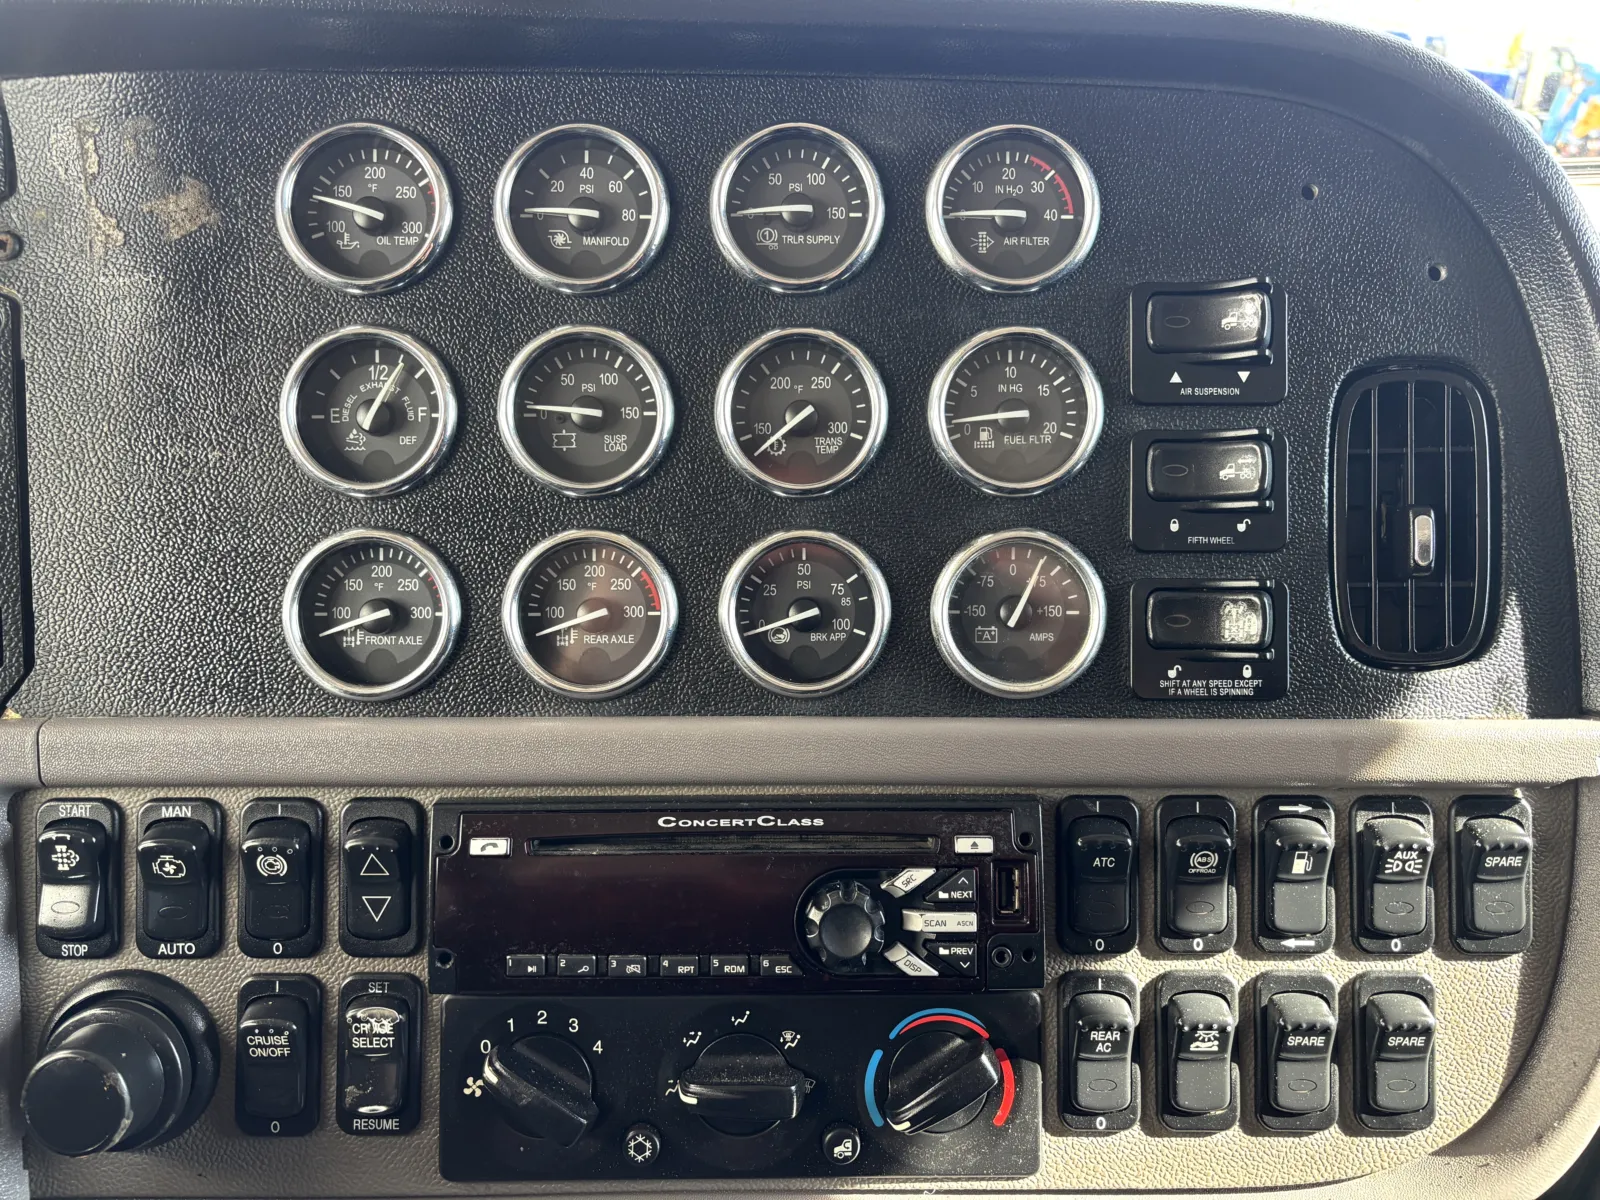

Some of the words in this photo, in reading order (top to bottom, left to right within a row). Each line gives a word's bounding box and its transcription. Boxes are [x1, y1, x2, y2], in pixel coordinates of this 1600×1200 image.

[364, 167, 385, 179] 200
[580, 168, 594, 179] 40
[1002, 168, 1016, 180] 20
[768, 174, 782, 186] 50
[806, 174, 825, 186] 100
[332, 186, 352, 198] 150
[395, 187, 417, 198] 250
[551, 181, 564, 193] 20
[579, 185, 594, 194] PSI
[609, 181, 622, 193] 60
[789, 184, 803, 192] PSI
[972, 182, 983, 193] 10
[995, 185, 1002, 194] IN
[1031, 181, 1044, 193] 30
[622, 209, 635, 221] 80
[826, 207, 845, 219] 150
[1044, 210, 1057, 221] 40
[326, 221, 346, 233] 100
[402, 222, 422, 234] 300
[376, 237, 392, 246] OIL
[394, 237, 419, 246] TEMP
[583, 237, 629, 246] MANIFOLD
[782, 235, 804, 244] TRLR
[806, 235, 840, 244] SUPPLY
[1004, 237, 1018, 246] AIR
[1020, 237, 1049, 246] FILTER
[368, 365, 388, 380] 1/2
[1005, 366, 1017, 378] 10
[561, 374, 575, 386] 50
[599, 374, 618, 385] 100
[770, 377, 791, 389] 200
[811, 377, 832, 389] 250
[582, 384, 595, 393] PSI
[971, 386, 977, 397] 5
[998, 384, 1006, 392] IN
[1008, 384, 1023, 393] HG
[1038, 384, 1049, 396] 15
[342, 394, 358, 422] DIESEL
[360, 380, 401, 394] EXHAST
[402, 396, 415, 421] FLUID
[331, 408, 340, 423] E
[418, 408, 426, 421] F
[620, 407, 639, 419] 150
[753, 423, 772, 435] 150
[827, 422, 848, 434] 300
[964, 424, 971, 435] 0
[1043, 422, 1057, 434] 20
[399, 436, 417, 445] DEF
[604, 435, 627, 443] SUSP
[814, 437, 842, 446] TRANS
[1004, 435, 1026, 444] FUEL
[1029, 435, 1052, 444] FLTR
[604, 443, 627, 452] LOAD
[816, 445, 839, 454] TEMP
[371, 565, 393, 578] 200
[584, 565, 605, 578] 200
[797, 564, 811, 576] 50
[1009, 564, 1016, 575] 0
[344, 580, 363, 591] 150
[397, 579, 419, 591] 250
[557, 579, 577, 591] 150
[610, 579, 632, 591] 250
[797, 581, 811, 589] PSI
[977, 575, 994, 588] -75
[763, 584, 777, 596] 25
[831, 583, 845, 595] 75
[841, 597, 851, 606] 85
[331, 607, 351, 619] 100
[410, 607, 432, 619] 300
[545, 606, 565, 619] 100
[623, 606, 644, 618] 300
[964, 605, 985, 617] -150
[1037, 605, 1062, 617] +150
[832, 618, 850, 630] 100
[365, 636, 396, 645] FRONT
[398, 635, 422, 645] AXLE
[584, 635, 608, 644] REAR
[610, 635, 635, 644] AXLE
[811, 633, 827, 641] BRK
[829, 632, 846, 641] APP
[1029, 633, 1054, 642] AMPS
[59, 805, 91, 816] START
[162, 806, 191, 817] MAN
[1394, 851, 1419, 859] AUX
[1093, 858, 1115, 867] ATC
[1485, 856, 1523, 867] SPARE
[902, 874, 917, 888] SRC
[924, 919, 947, 927] SCAN
[62, 944, 88, 956] STOP
[158, 943, 196, 955] AUTO
[560, 959, 565, 967] 2
[611, 960, 616, 968] 3
[904, 959, 922, 973] DISP
[678, 966, 694, 974] RPT
[724, 965, 745, 973] RDM
[775, 965, 792, 974] ESC
[368, 982, 389, 993] SET
[537, 1011, 547, 1024] 2
[508, 1019, 513, 1031] 1
[569, 1019, 579, 1032] 3
[247, 1035, 289, 1045] CRUISE
[1091, 1031, 1120, 1041] REAR
[1287, 1036, 1325, 1047] SPARE
[1388, 1036, 1425, 1047] SPARE
[352, 1037, 395, 1048] SELECT
[481, 1040, 491, 1053] 0
[593, 1041, 603, 1053] 4
[1096, 1042, 1112, 1052] AC
[249, 1047, 291, 1057] ON/OFF
[353, 1119, 400, 1130] RESUME
